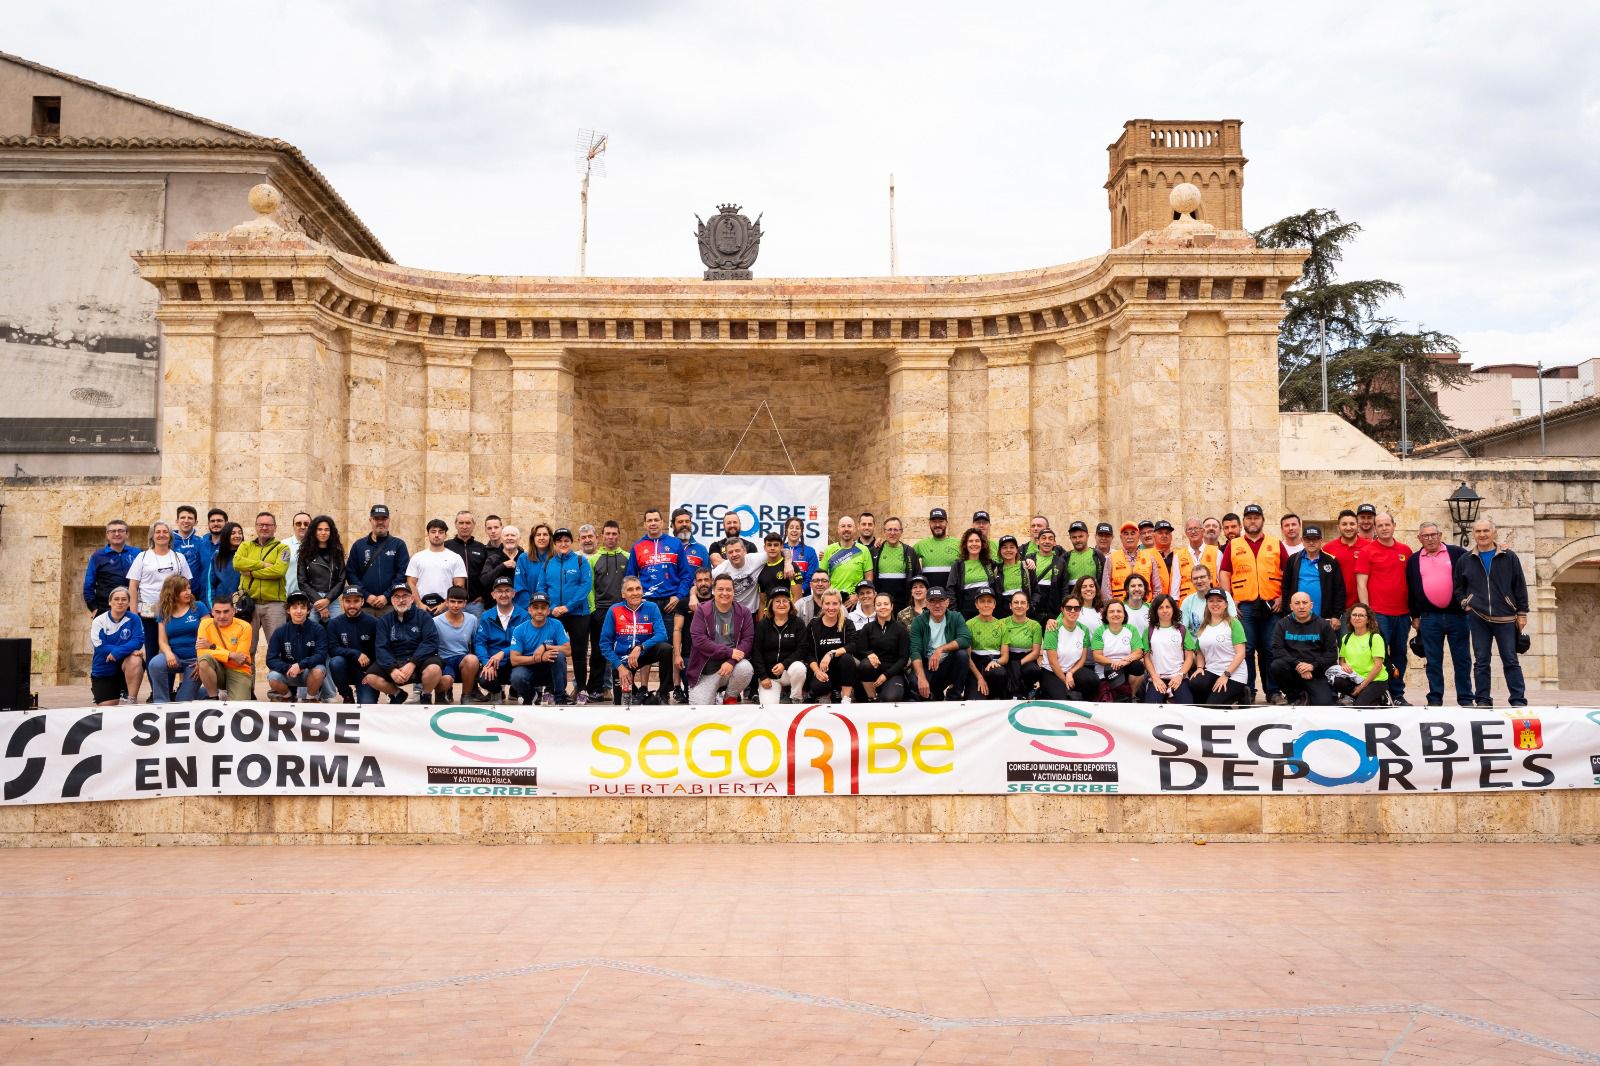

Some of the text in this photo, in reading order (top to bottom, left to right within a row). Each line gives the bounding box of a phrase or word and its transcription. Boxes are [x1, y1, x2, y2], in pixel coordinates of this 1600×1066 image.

[131, 709, 360, 746] SEGORBE
[1151, 721, 1509, 761] SEGORBE
[429, 767, 458, 775] CONSEJO
[459, 768, 491, 776] MUNICIPAL
[502, 768, 535, 777] DEPORTES
[1008, 763, 1117, 772] CONSEJO MUNICIPAL DE DEPORTES
[1159, 752, 1556, 791] DEPORTES
[136, 754, 385, 791] EN FORMA
[1072, 772, 1093, 780] FÍSICA
[458, 776, 490, 784] ACTIVIDAD
[427, 786, 538, 795] SEGORBE
[1007, 783, 1119, 792] SEGORBE
